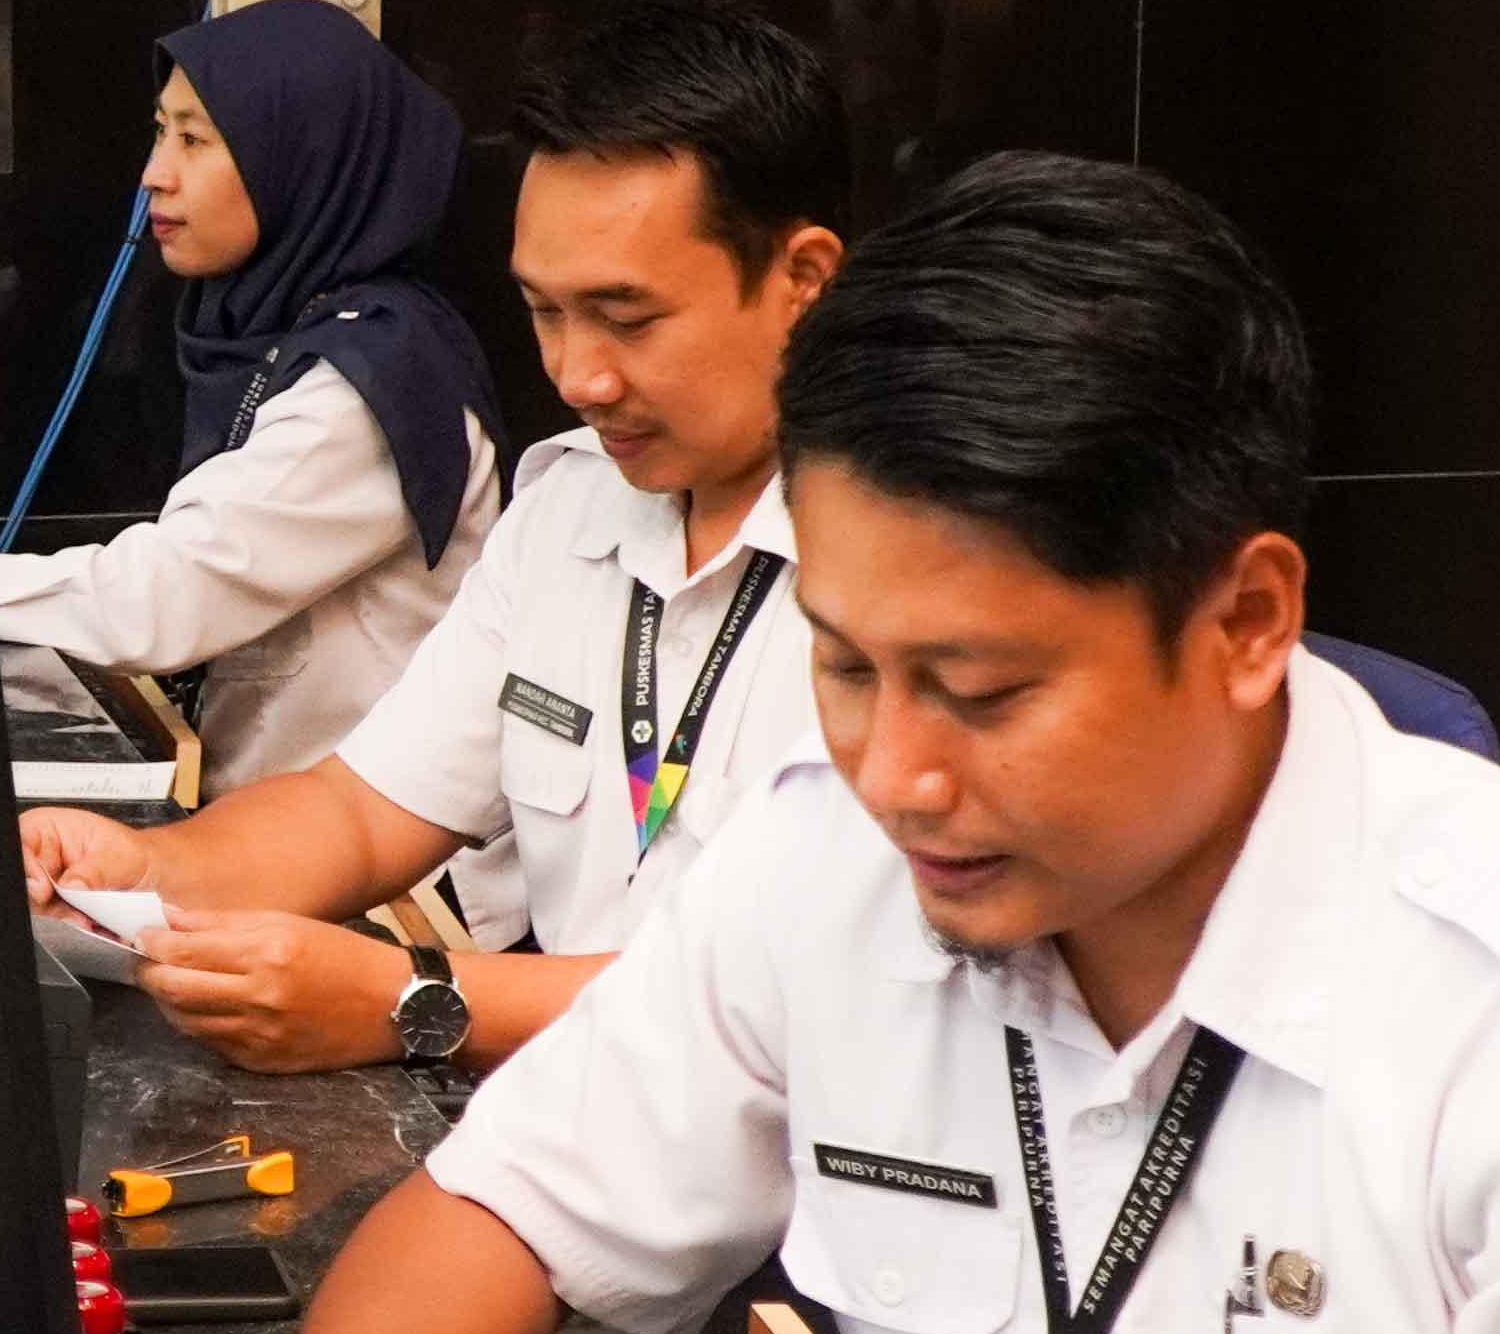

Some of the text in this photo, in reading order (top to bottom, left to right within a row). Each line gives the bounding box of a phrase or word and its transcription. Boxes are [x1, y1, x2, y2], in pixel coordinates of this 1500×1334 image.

[635, 617, 654, 706] PUSKESMAS
[687, 557, 769, 717] PUSKESMAS TAMBORA
[826, 1157, 984, 1200] WIBY PRADANA
[1012, 1067, 1045, 1208] PARIPURNA
[1083, 1058, 1209, 1315] SEMANGAT AKREDITASI
[1124, 1135, 1196, 1264] PARIPURNA
